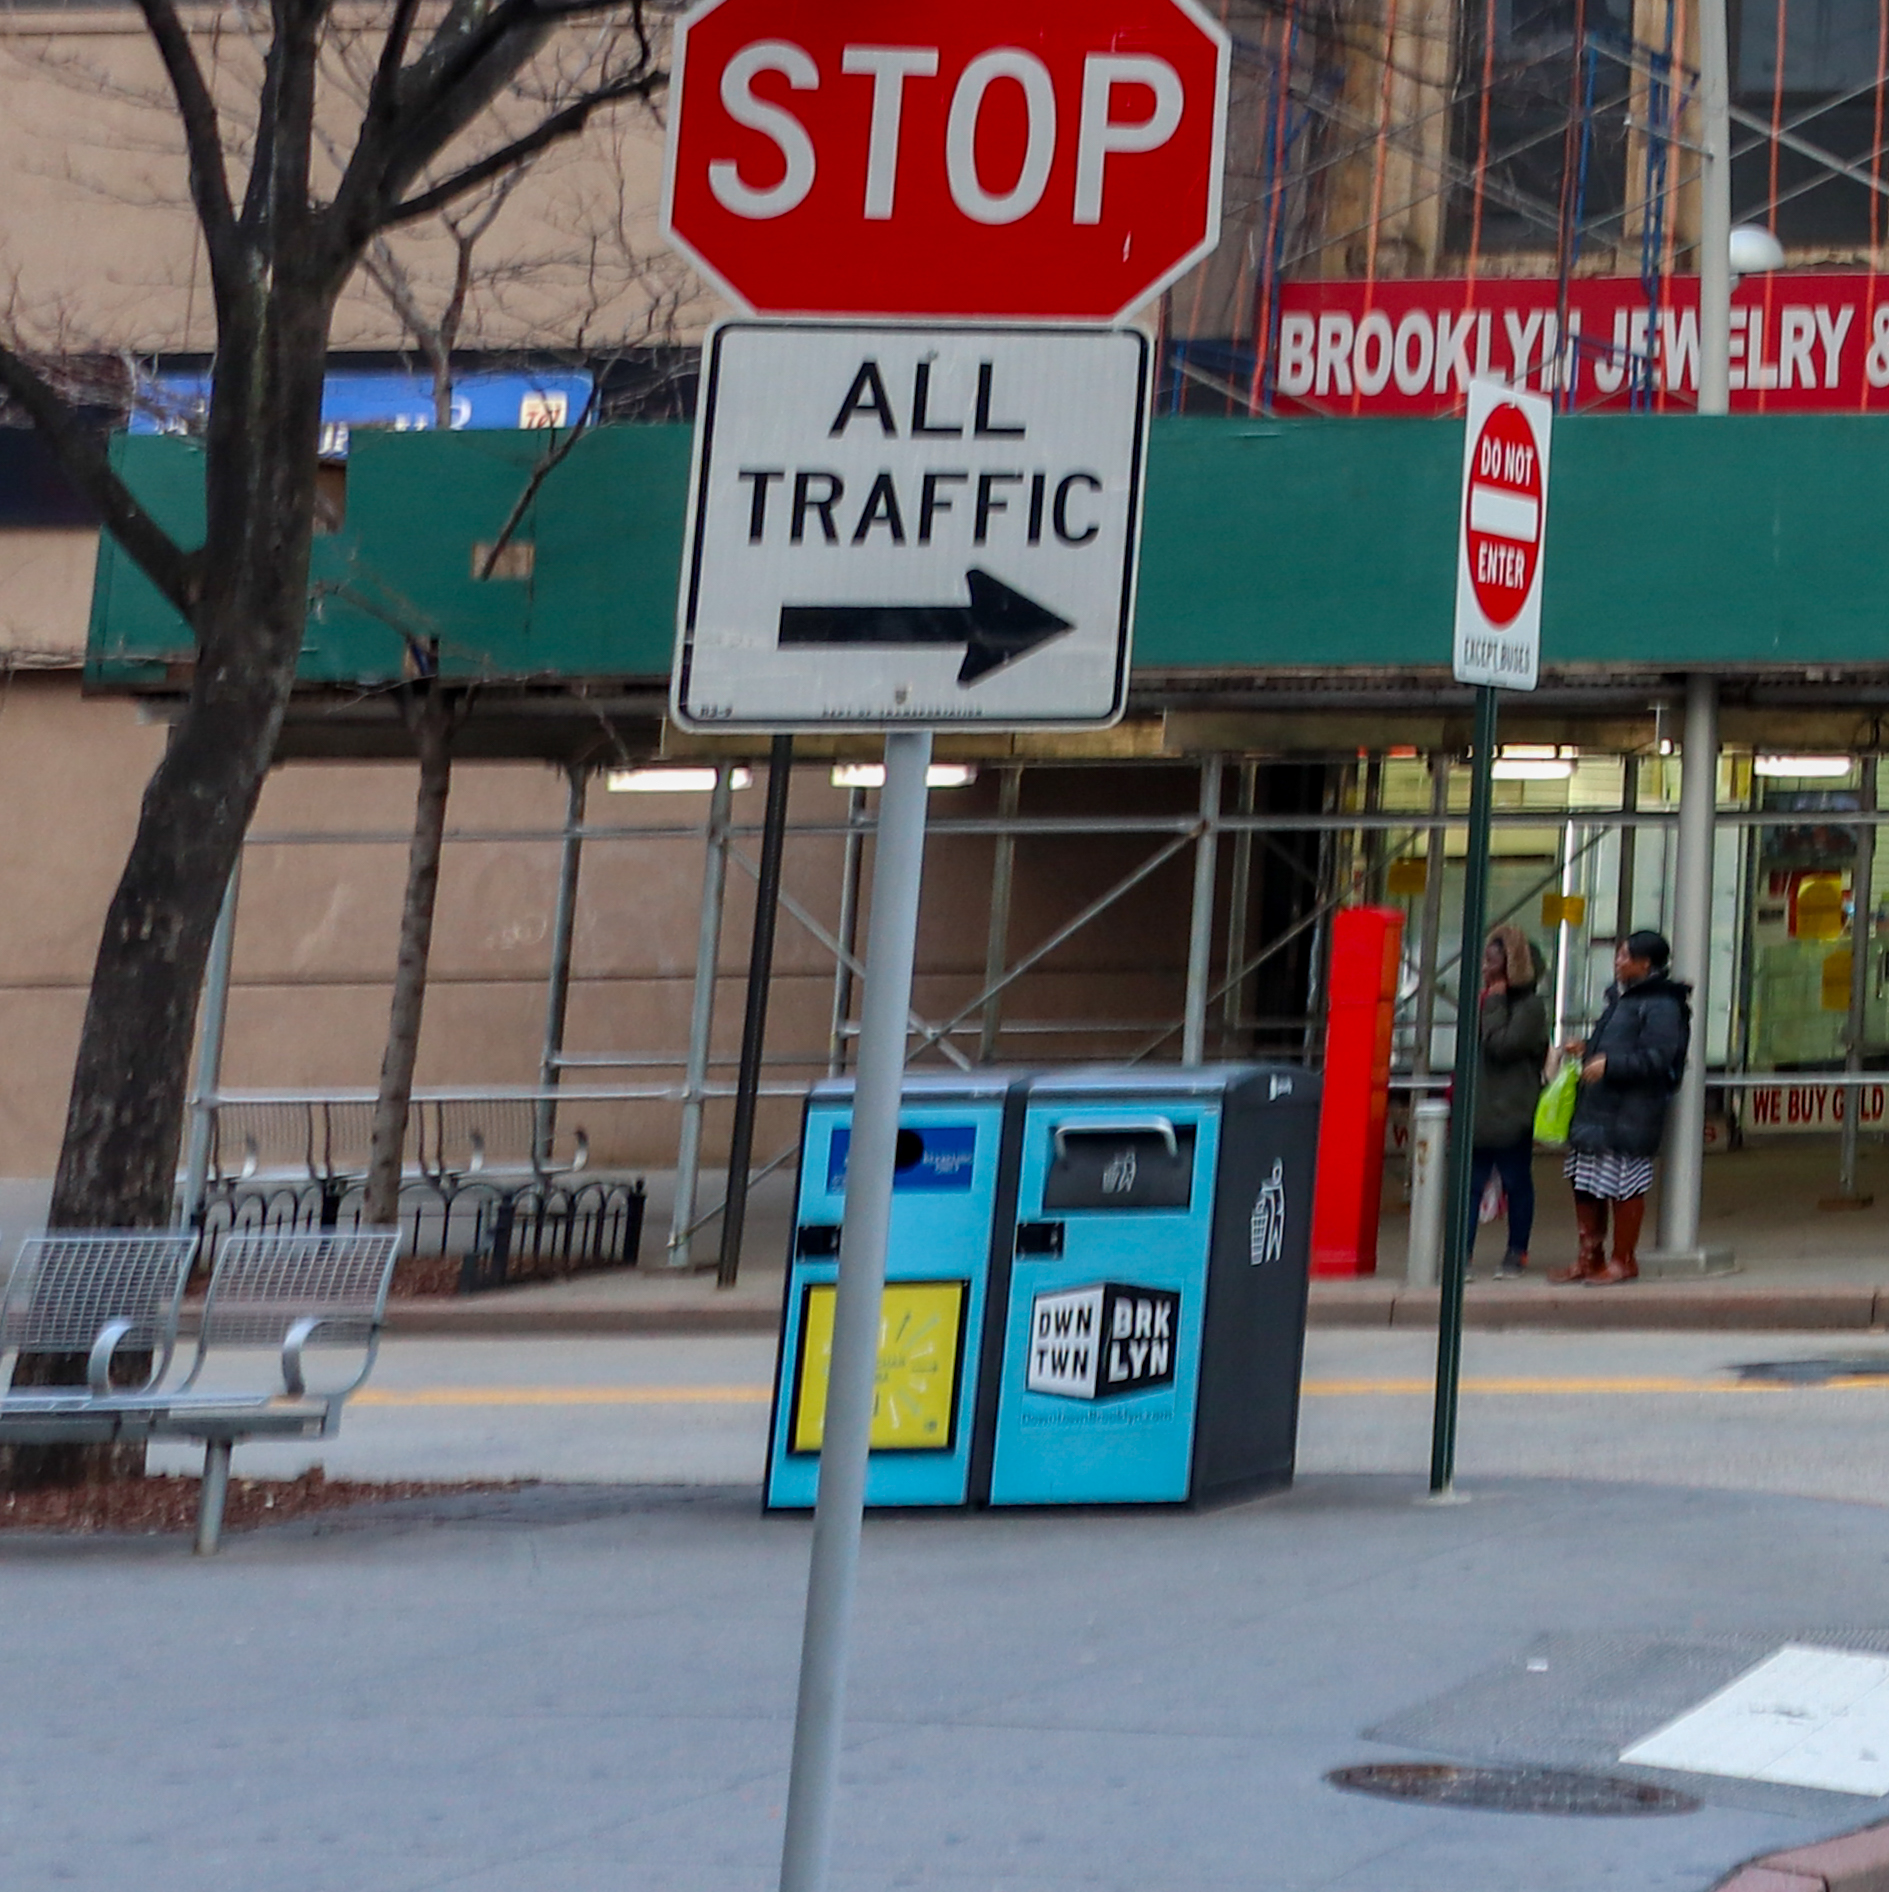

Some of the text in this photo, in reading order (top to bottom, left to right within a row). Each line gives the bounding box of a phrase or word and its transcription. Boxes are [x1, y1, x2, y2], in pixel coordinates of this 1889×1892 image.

[708, 40, 1184, 225] STOP
[1277, 308, 1582, 397] BROOKLYN
[1594, 306, 1855, 392] JEWELRY
[829, 357, 1026, 439] ALL
[1481, 434, 1533, 486] DO NOT
[738, 468, 1102, 546] TRAFFIC
[1477, 540, 1525, 589] ENTER
[1464, 636, 1530, 674] EXCEPT BUSES
[1754, 1087, 1780, 1124] WE
[1788, 1086, 1827, 1123] BUY
[1832, 1084, 1884, 1122] GLD
[1038, 1305, 1093, 1339] DWN
[1112, 1297, 1171, 1339] BRK
[1036, 1348, 1088, 1379] TWN
[1108, 1339, 1169, 1383] LYN
